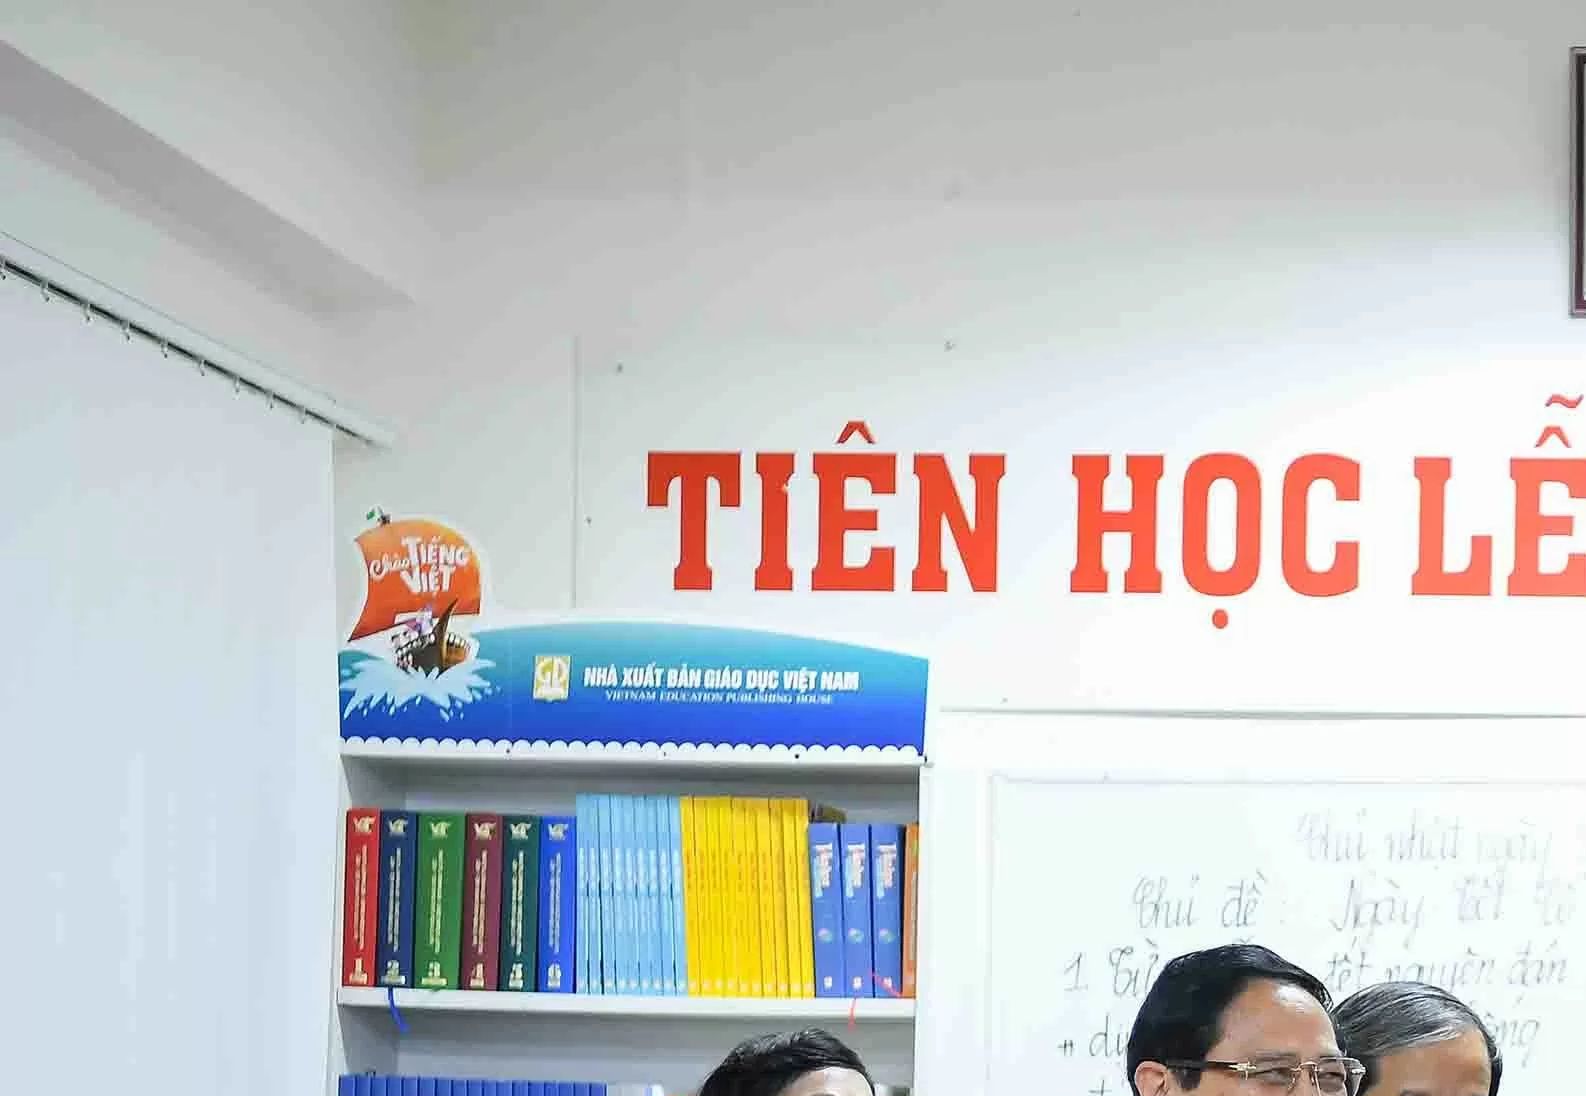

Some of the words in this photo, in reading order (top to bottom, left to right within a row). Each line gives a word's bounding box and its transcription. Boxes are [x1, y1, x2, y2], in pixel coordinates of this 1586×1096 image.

[646, 420, 1007, 593] TIÊN
[1069, 451, 1362, 630] HỌC
[400, 534, 470, 568] TIẾNG
[400, 562, 457, 598] VIỆT
[583, 663, 619, 688] NHÀ
[622, 661, 665, 689] XUẤT
[667, 662, 702, 689] BẢN
[703, 664, 743, 690] GIÁO
[745, 668, 780, 693] DỤC
[783, 666, 818, 694] VIỆT
[820, 671, 860, 691] NAM
